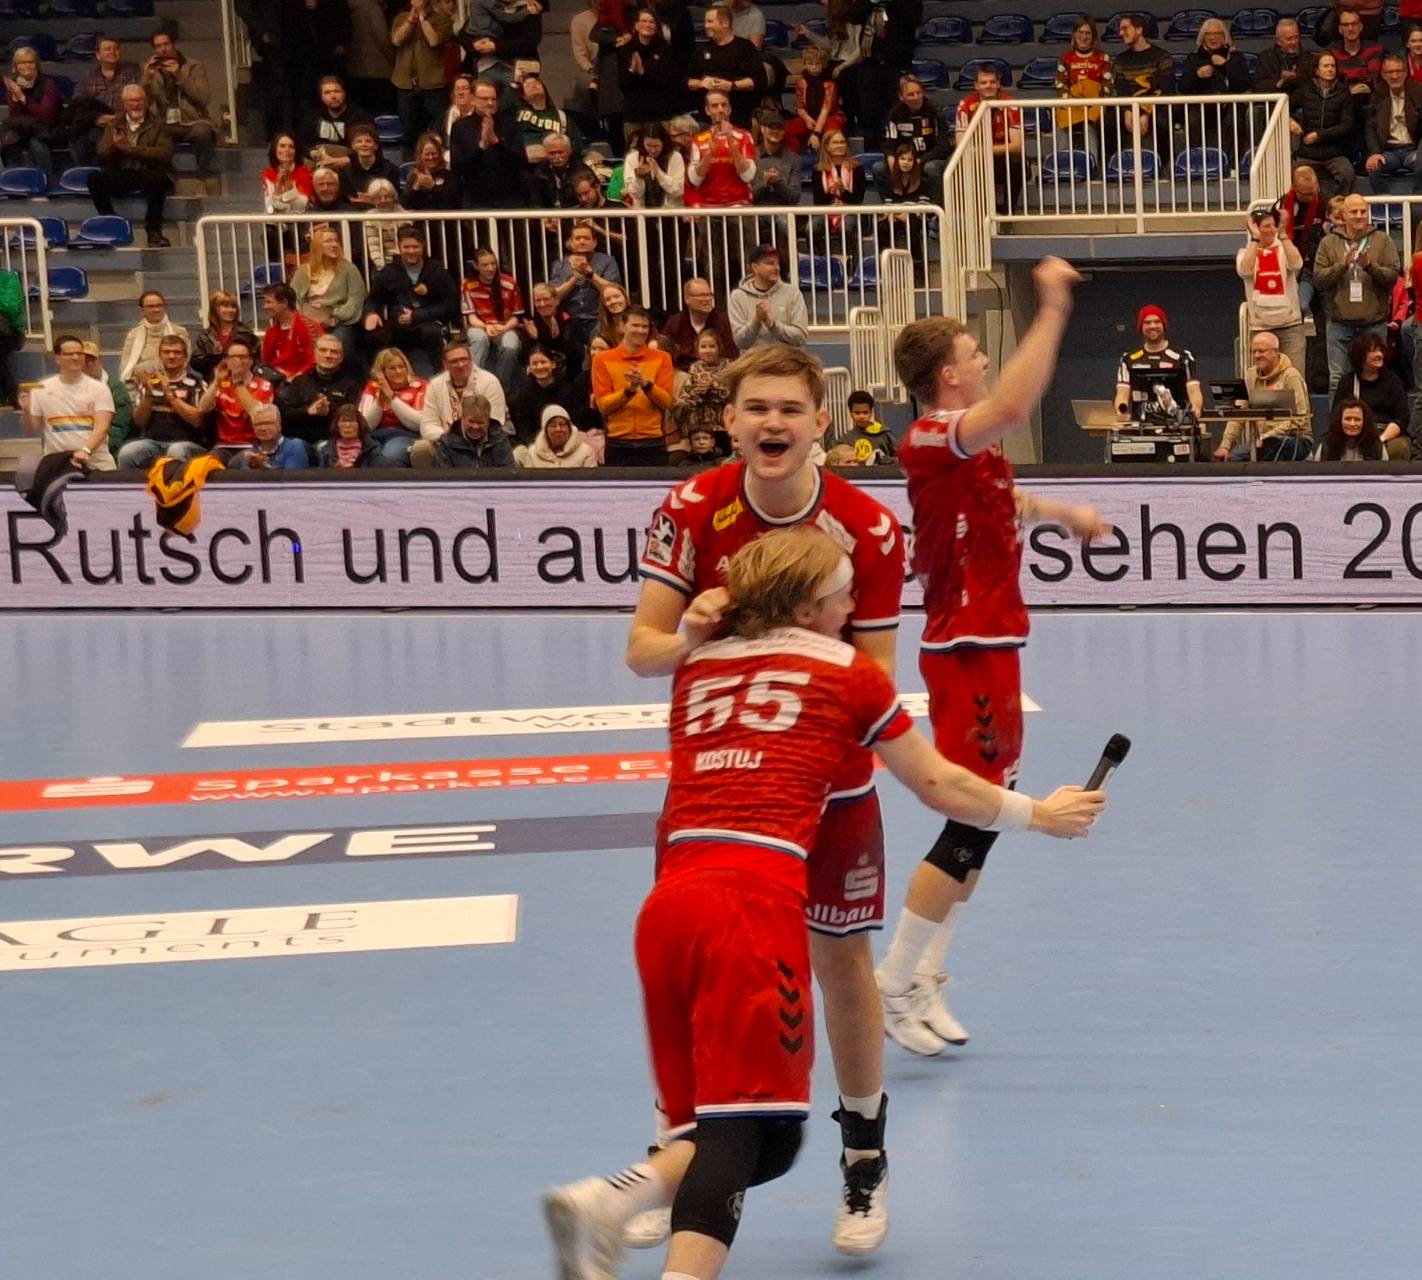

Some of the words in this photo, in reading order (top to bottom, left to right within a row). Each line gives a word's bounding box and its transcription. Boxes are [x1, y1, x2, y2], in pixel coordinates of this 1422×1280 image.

[7, 508, 304, 585] Rutsch
[342, 508, 500, 584] und
[537, 526, 652, 584] au
[1029, 503, 1302, 582] sehen
[685, 670, 812, 736] 55
[0, 909, 358, 946] GLE
[804, 903, 876, 925] llbau
[18, 935, 346, 960] uments
